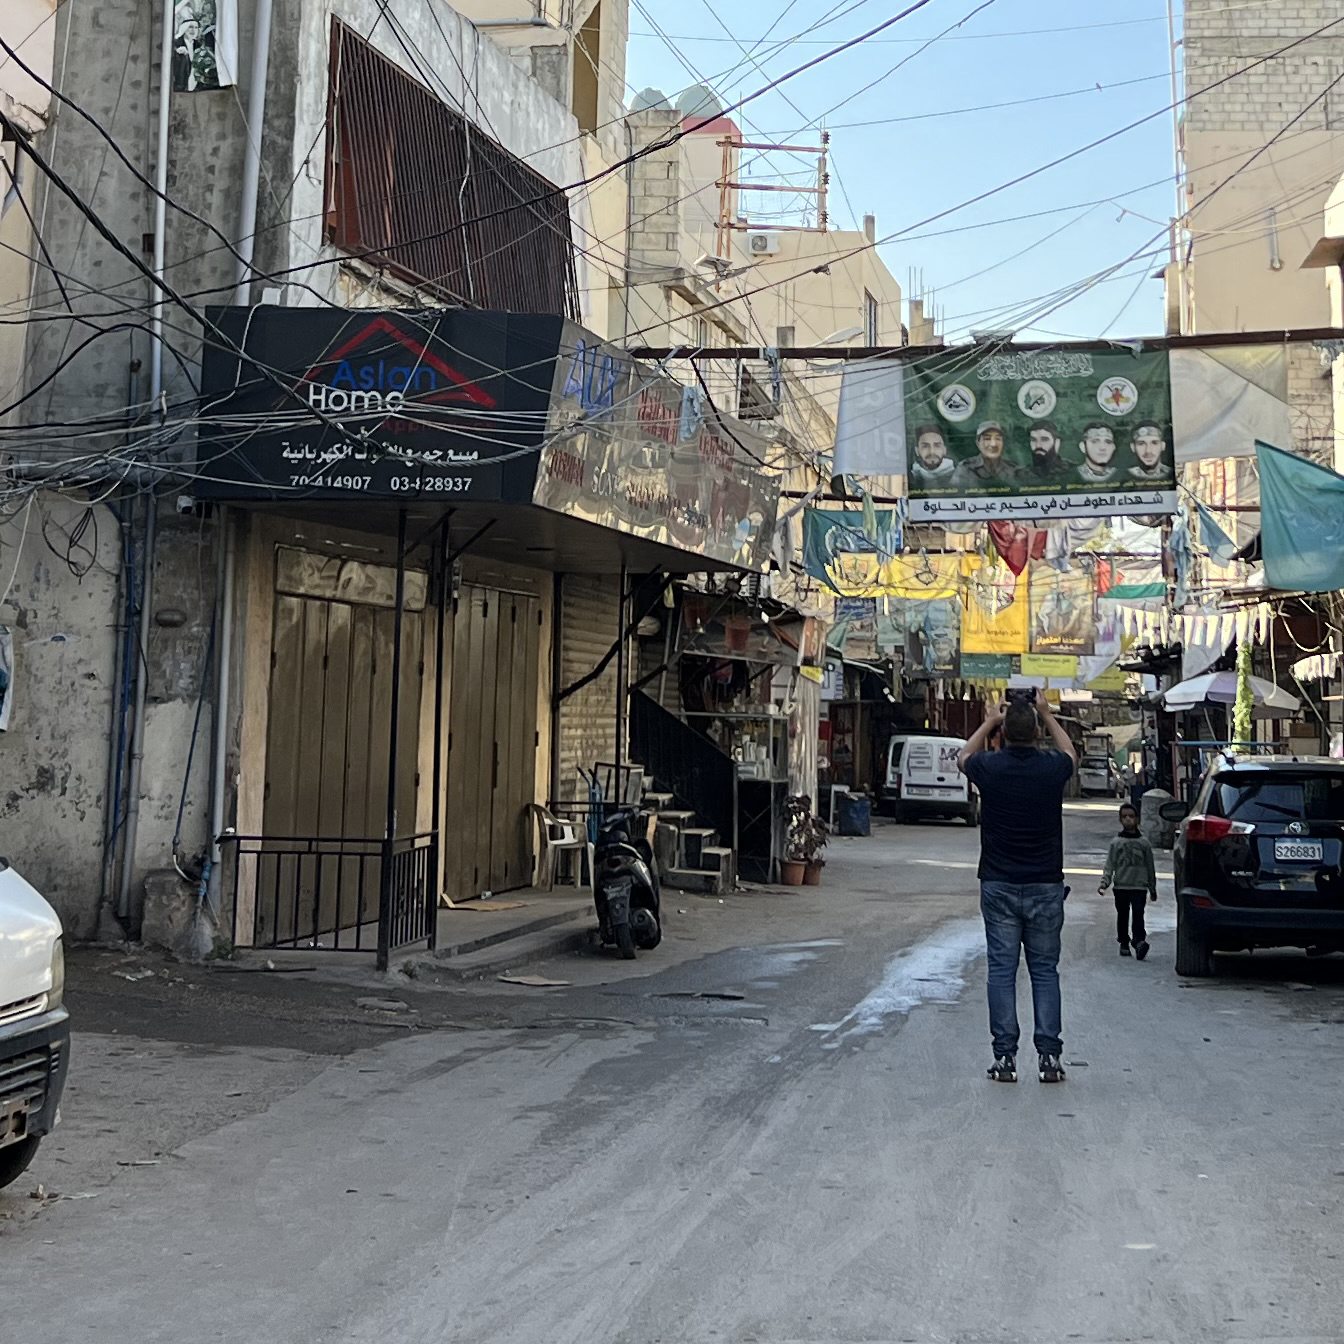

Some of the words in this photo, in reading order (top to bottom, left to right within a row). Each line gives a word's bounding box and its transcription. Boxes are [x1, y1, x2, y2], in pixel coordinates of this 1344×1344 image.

[308, 384, 405, 412] Home
[999, 497, 1039, 515] مخيم
[1040, 497, 1058, 514] في
[1117, 489, 1164, 506] شهداء
[923, 499, 967, 514] الحلوة
[967, 500, 997, 514] عين
[1275, 845, 1323, 859] S266831
